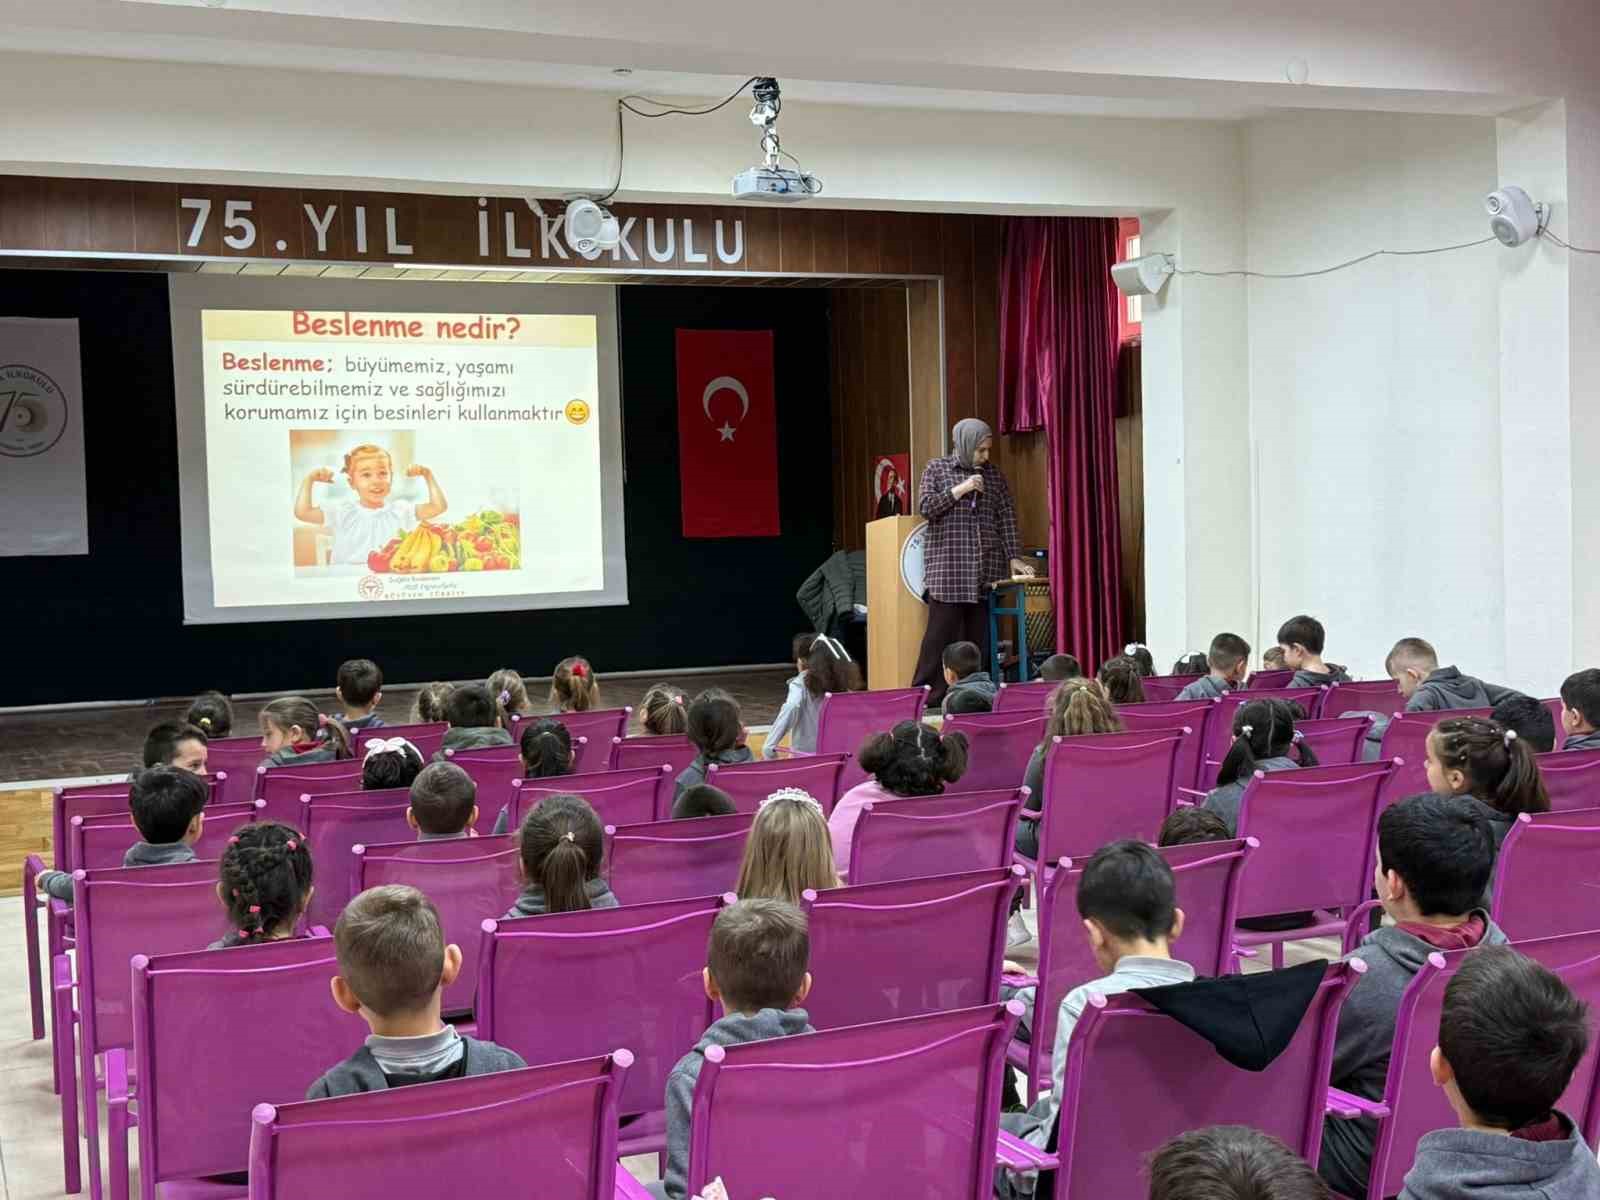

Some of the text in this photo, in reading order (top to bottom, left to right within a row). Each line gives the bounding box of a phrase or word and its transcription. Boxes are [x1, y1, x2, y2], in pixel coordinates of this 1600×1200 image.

[181, 198, 288, 250] 75.
[304, 203, 414, 255] YIL
[292, 309, 521, 340] Beslenme nedir?
[222, 352, 514, 378] Beslenme; büyümemiz, yaşamı
[223, 379, 506, 402] sürdürebilmemiz ve sağlığımızı
[225, 403, 563, 424] korumamız için besinleri kullanmaktır
